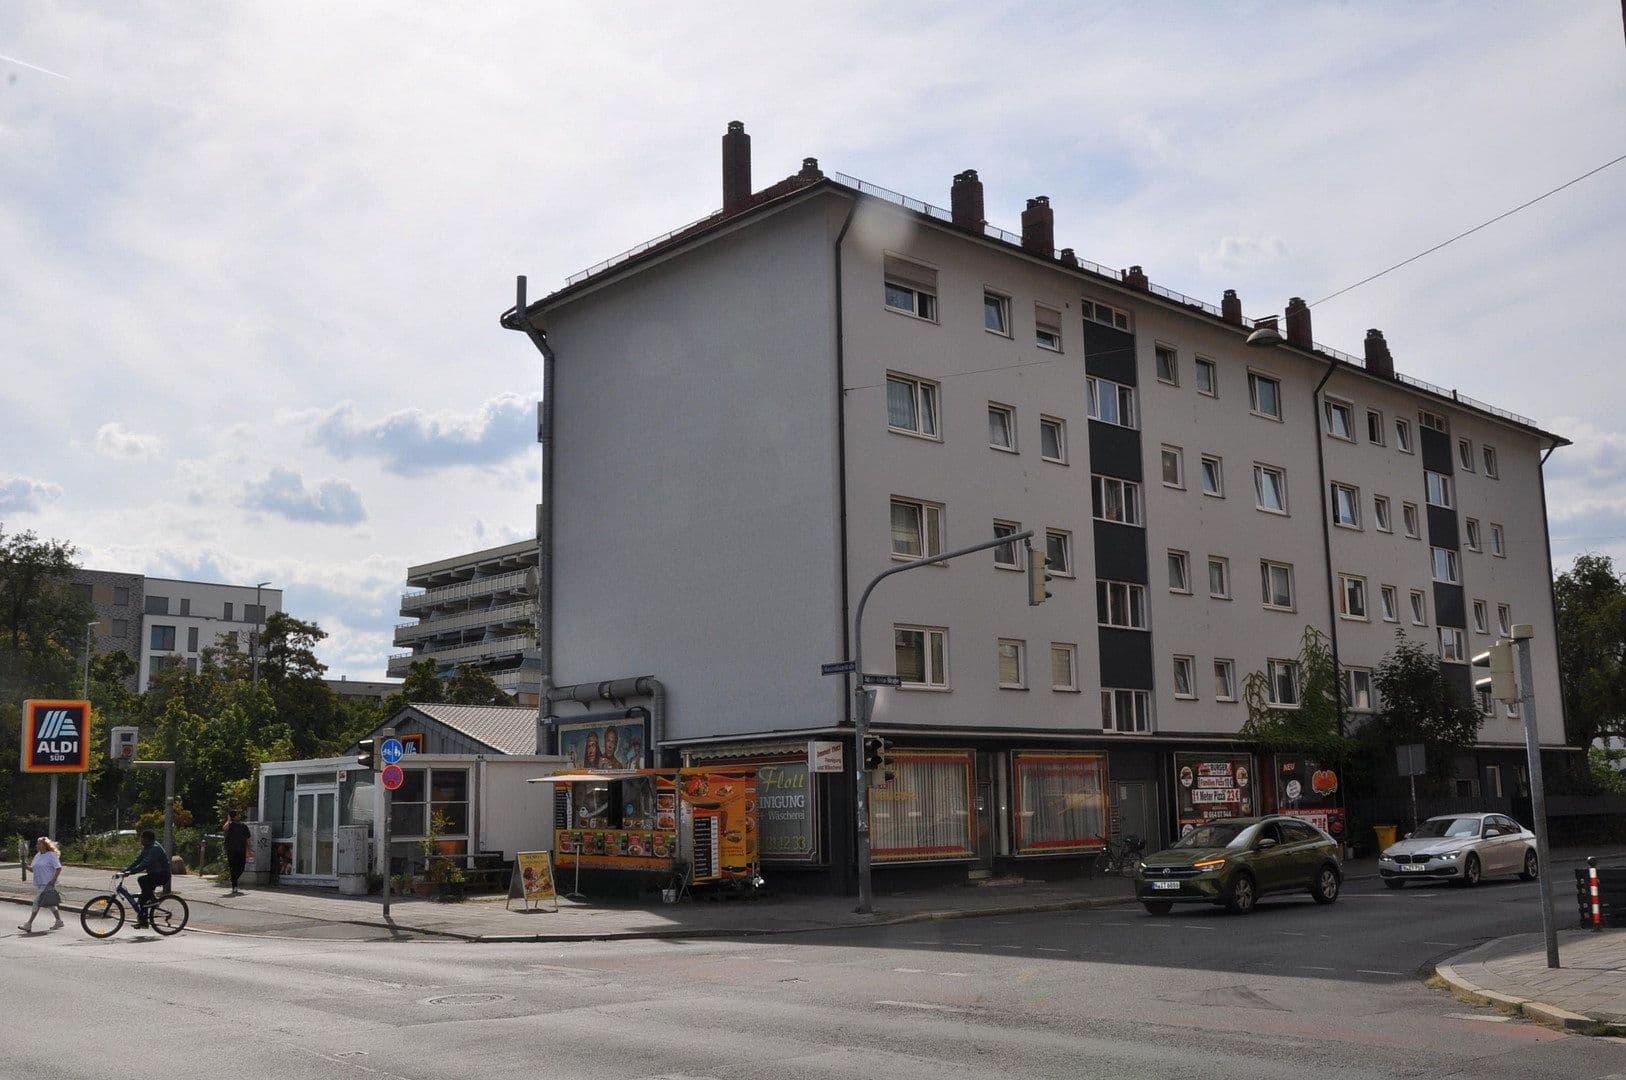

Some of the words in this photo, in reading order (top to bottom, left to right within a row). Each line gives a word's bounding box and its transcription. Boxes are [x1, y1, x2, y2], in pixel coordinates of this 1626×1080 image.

[37, 741, 78, 753] ALDI
[1283, 763, 1295, 772] NEU
[759, 766, 805, 792] Flott
[1214, 790, 1225, 800] Pizza
[759, 795, 804, 808] INIGUNG
[768, 810, 805, 820] Wäscherei
